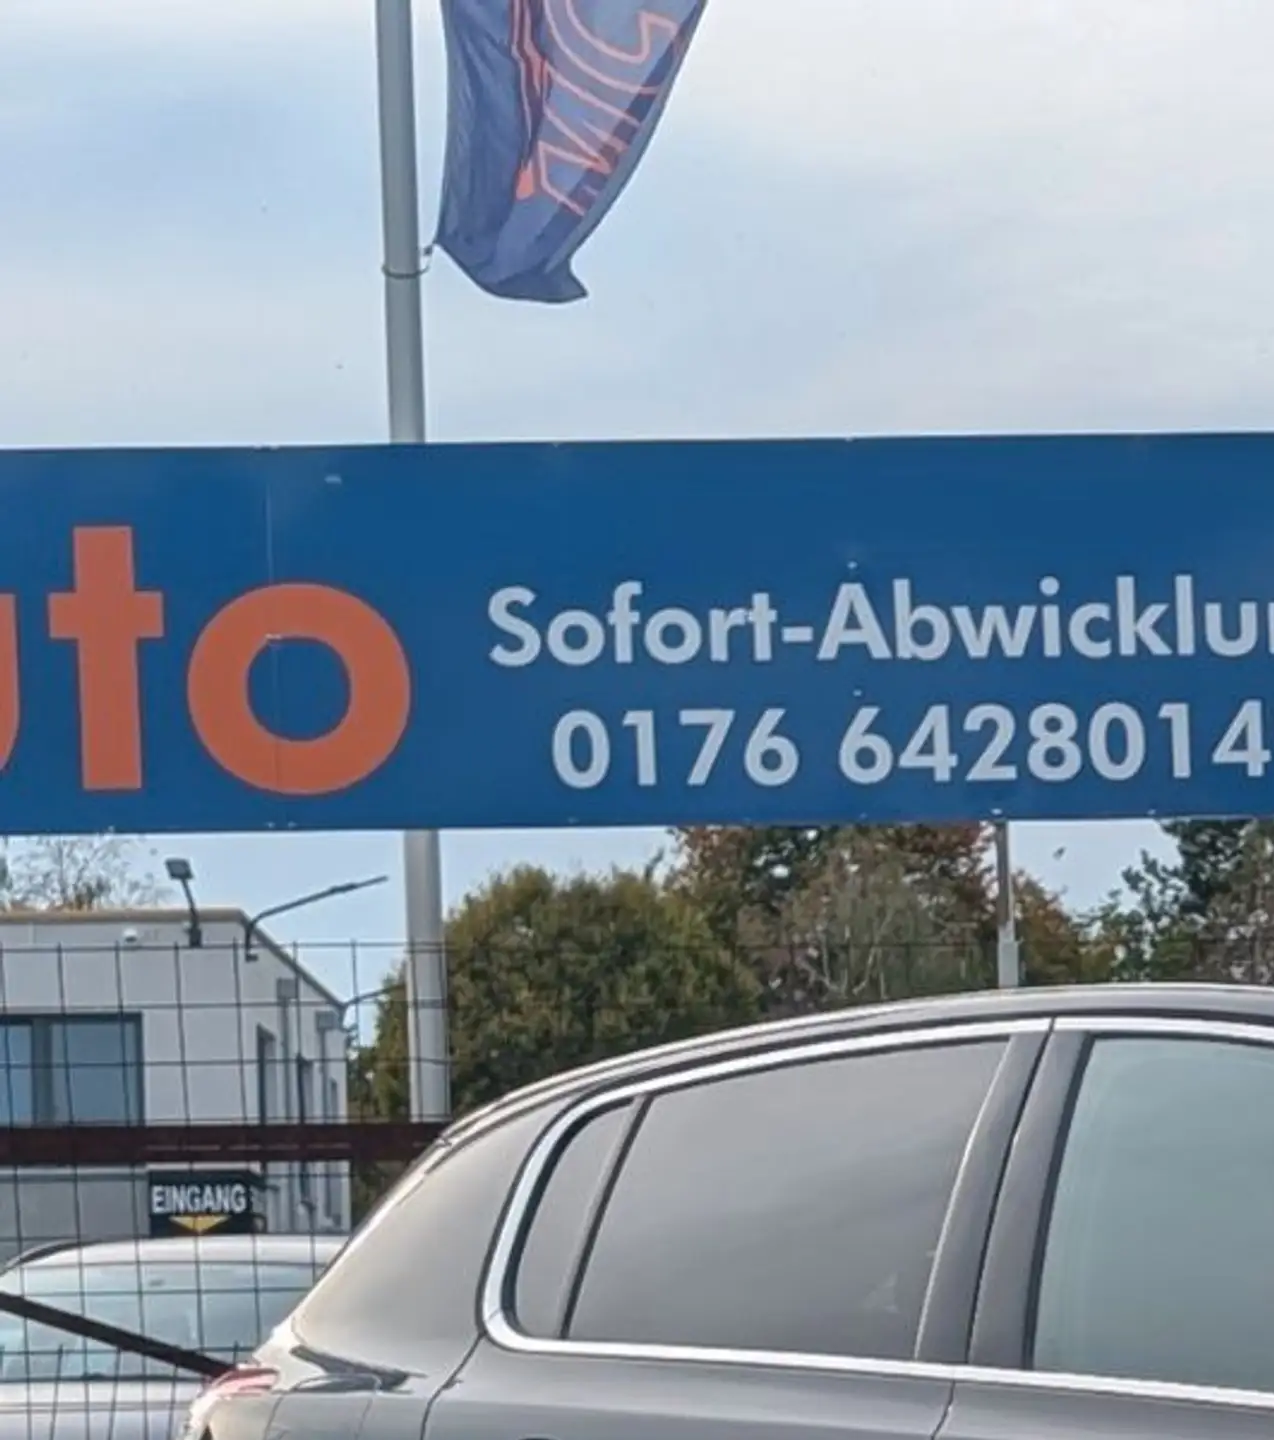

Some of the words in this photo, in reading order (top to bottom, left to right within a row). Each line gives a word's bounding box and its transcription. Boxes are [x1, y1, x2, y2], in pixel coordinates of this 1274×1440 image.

[0, 525, 412, 796] to
[551, 706, 800, 789] 0176
[151, 1183, 247, 1215] EINGANG
